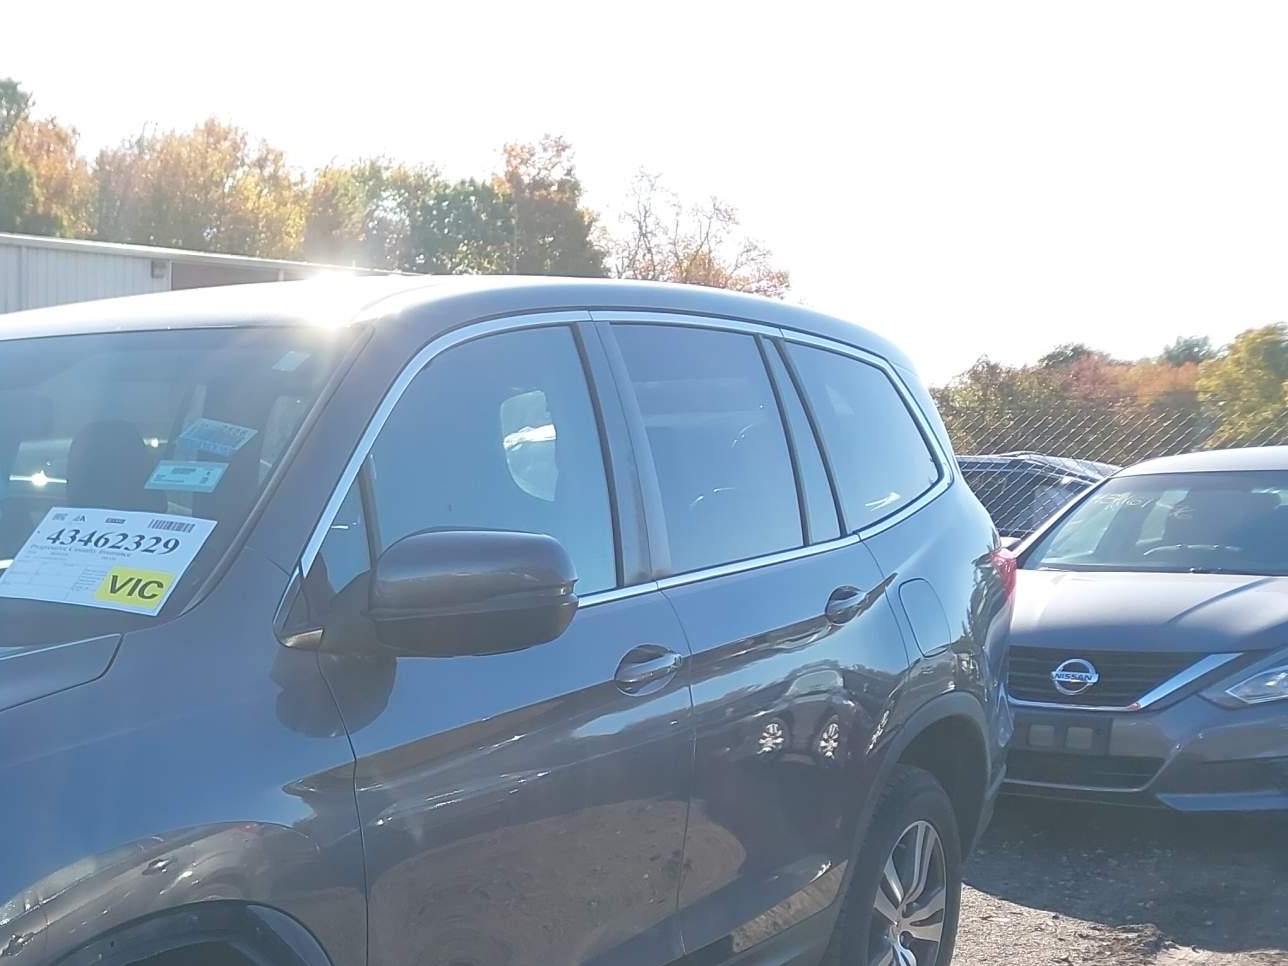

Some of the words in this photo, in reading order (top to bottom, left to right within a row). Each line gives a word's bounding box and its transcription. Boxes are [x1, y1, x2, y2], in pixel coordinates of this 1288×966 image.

[46, 527, 181, 556] 43462329
[109, 574, 165, 600] VIC
[1054, 672, 1093, 681] NISSAN
